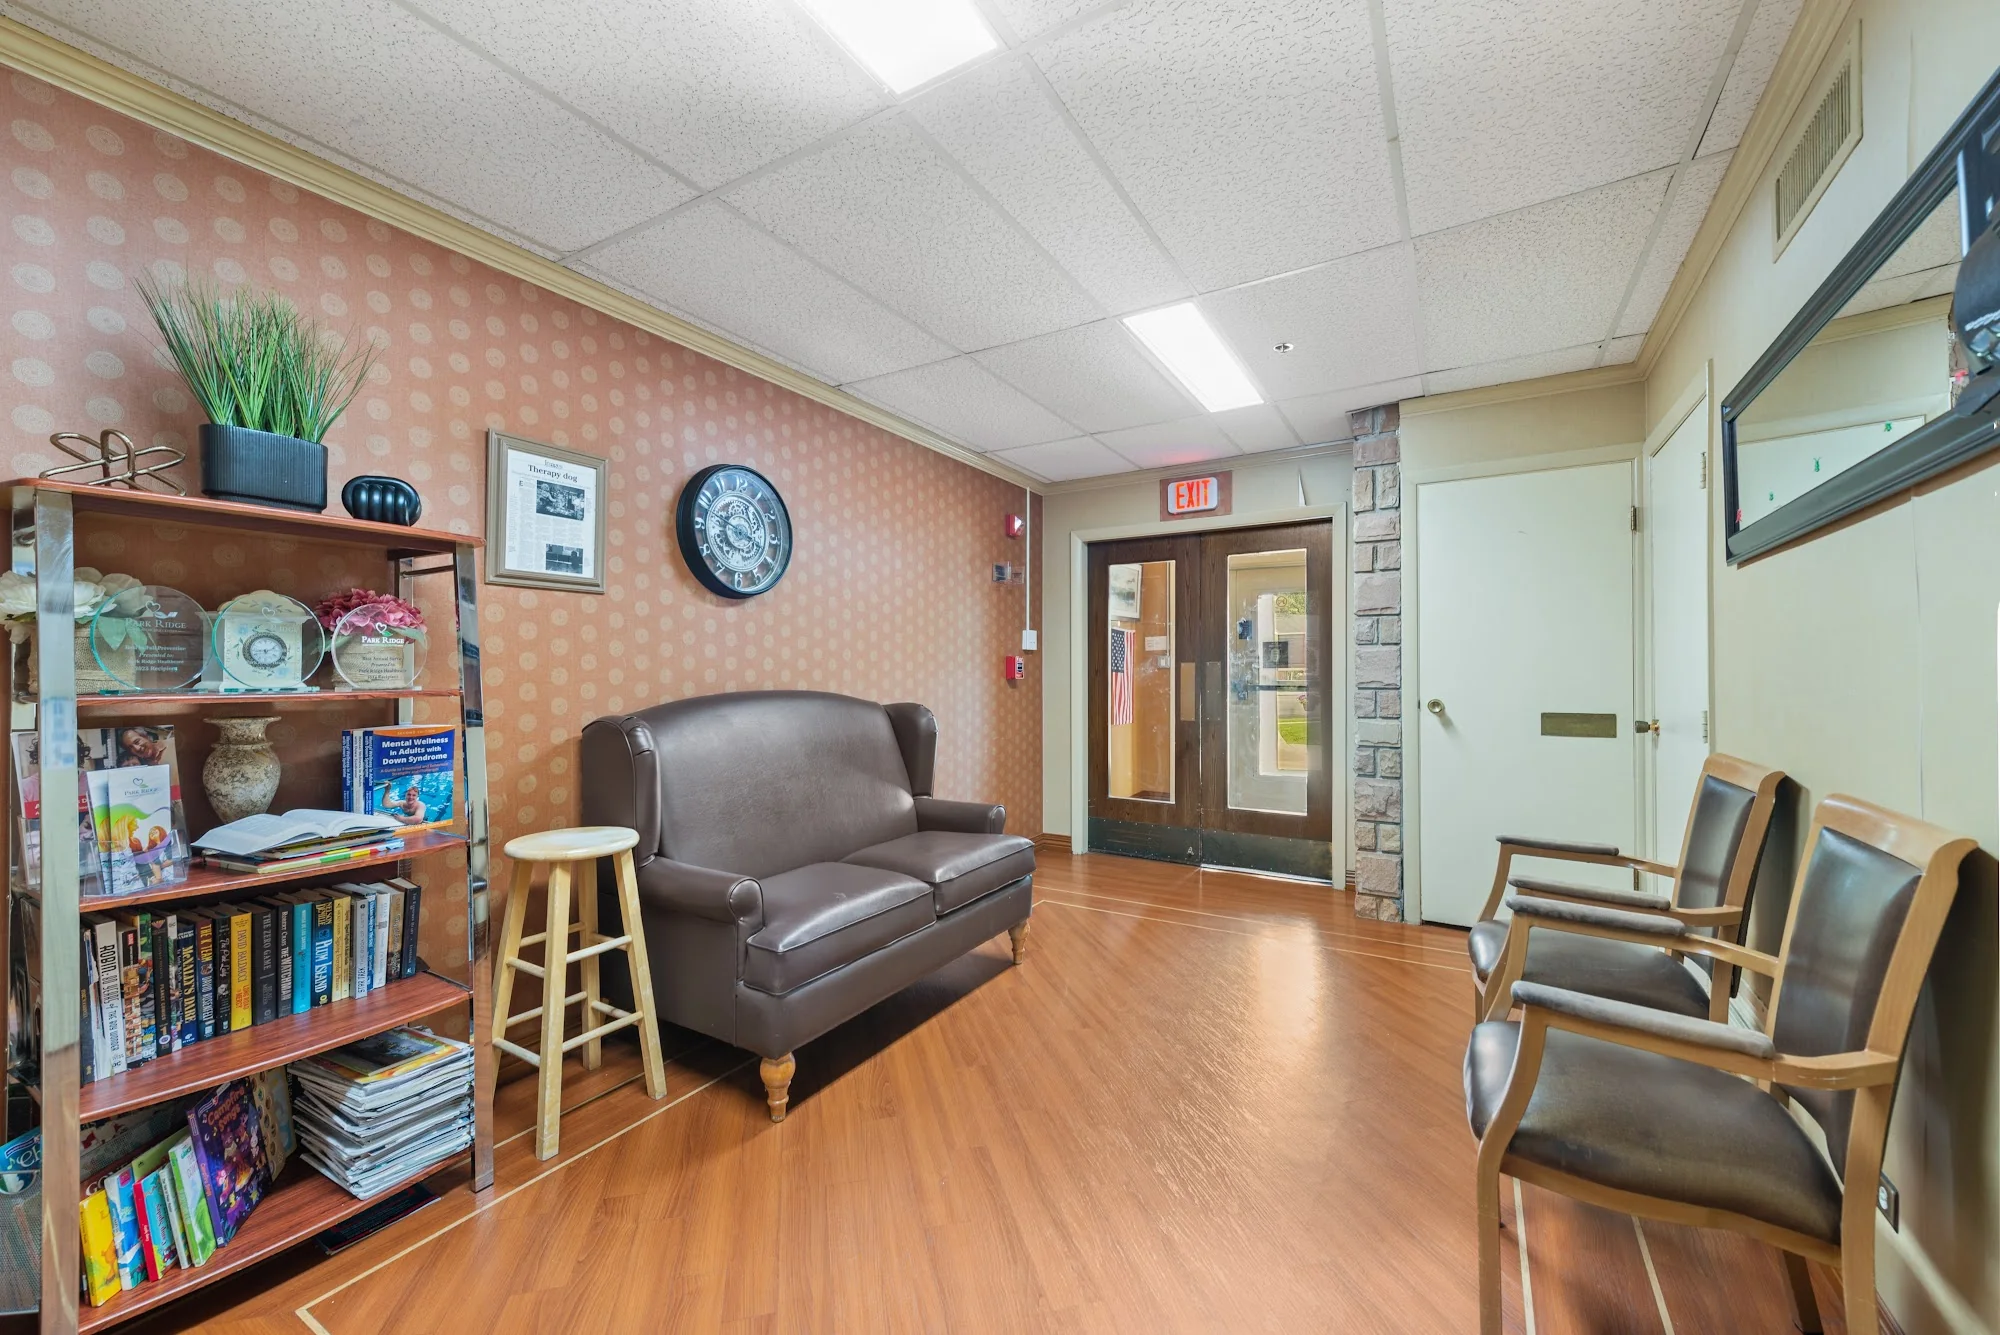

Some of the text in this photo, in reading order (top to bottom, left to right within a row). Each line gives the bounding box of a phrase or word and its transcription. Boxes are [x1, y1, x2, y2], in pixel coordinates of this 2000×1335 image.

[528, 464, 561, 479] Therapy
[562, 472, 578, 483] dog
[735, 476, 748, 492] 12
[1176, 479, 1210, 510] EXIT
[734, 572, 743, 589] 6
[155, 620, 187, 628] RIDGE
[382, 737, 448, 748] Mental Wellness
[382, 753, 448, 766] Down Syndrome
[398, 747, 426, 756] Adults
[200, 924, 212, 937] THE
[238, 930, 247, 948] DAVID
[220, 938, 230, 948] The
[262, 914, 272, 970] THE ZERO GAME
[201, 946, 212, 962] TEAM
[182, 945, 194, 994] McNALLY'S
[238, 952, 248, 982] BALDACCI
[314, 938, 332, 993] PLUM ISLAND
[202, 976, 212, 992] DAVID
[280, 956, 292, 1000] WATCHMAN
[184, 996, 196, 1024] DARE
[208, 1086, 245, 1125] Campfire
